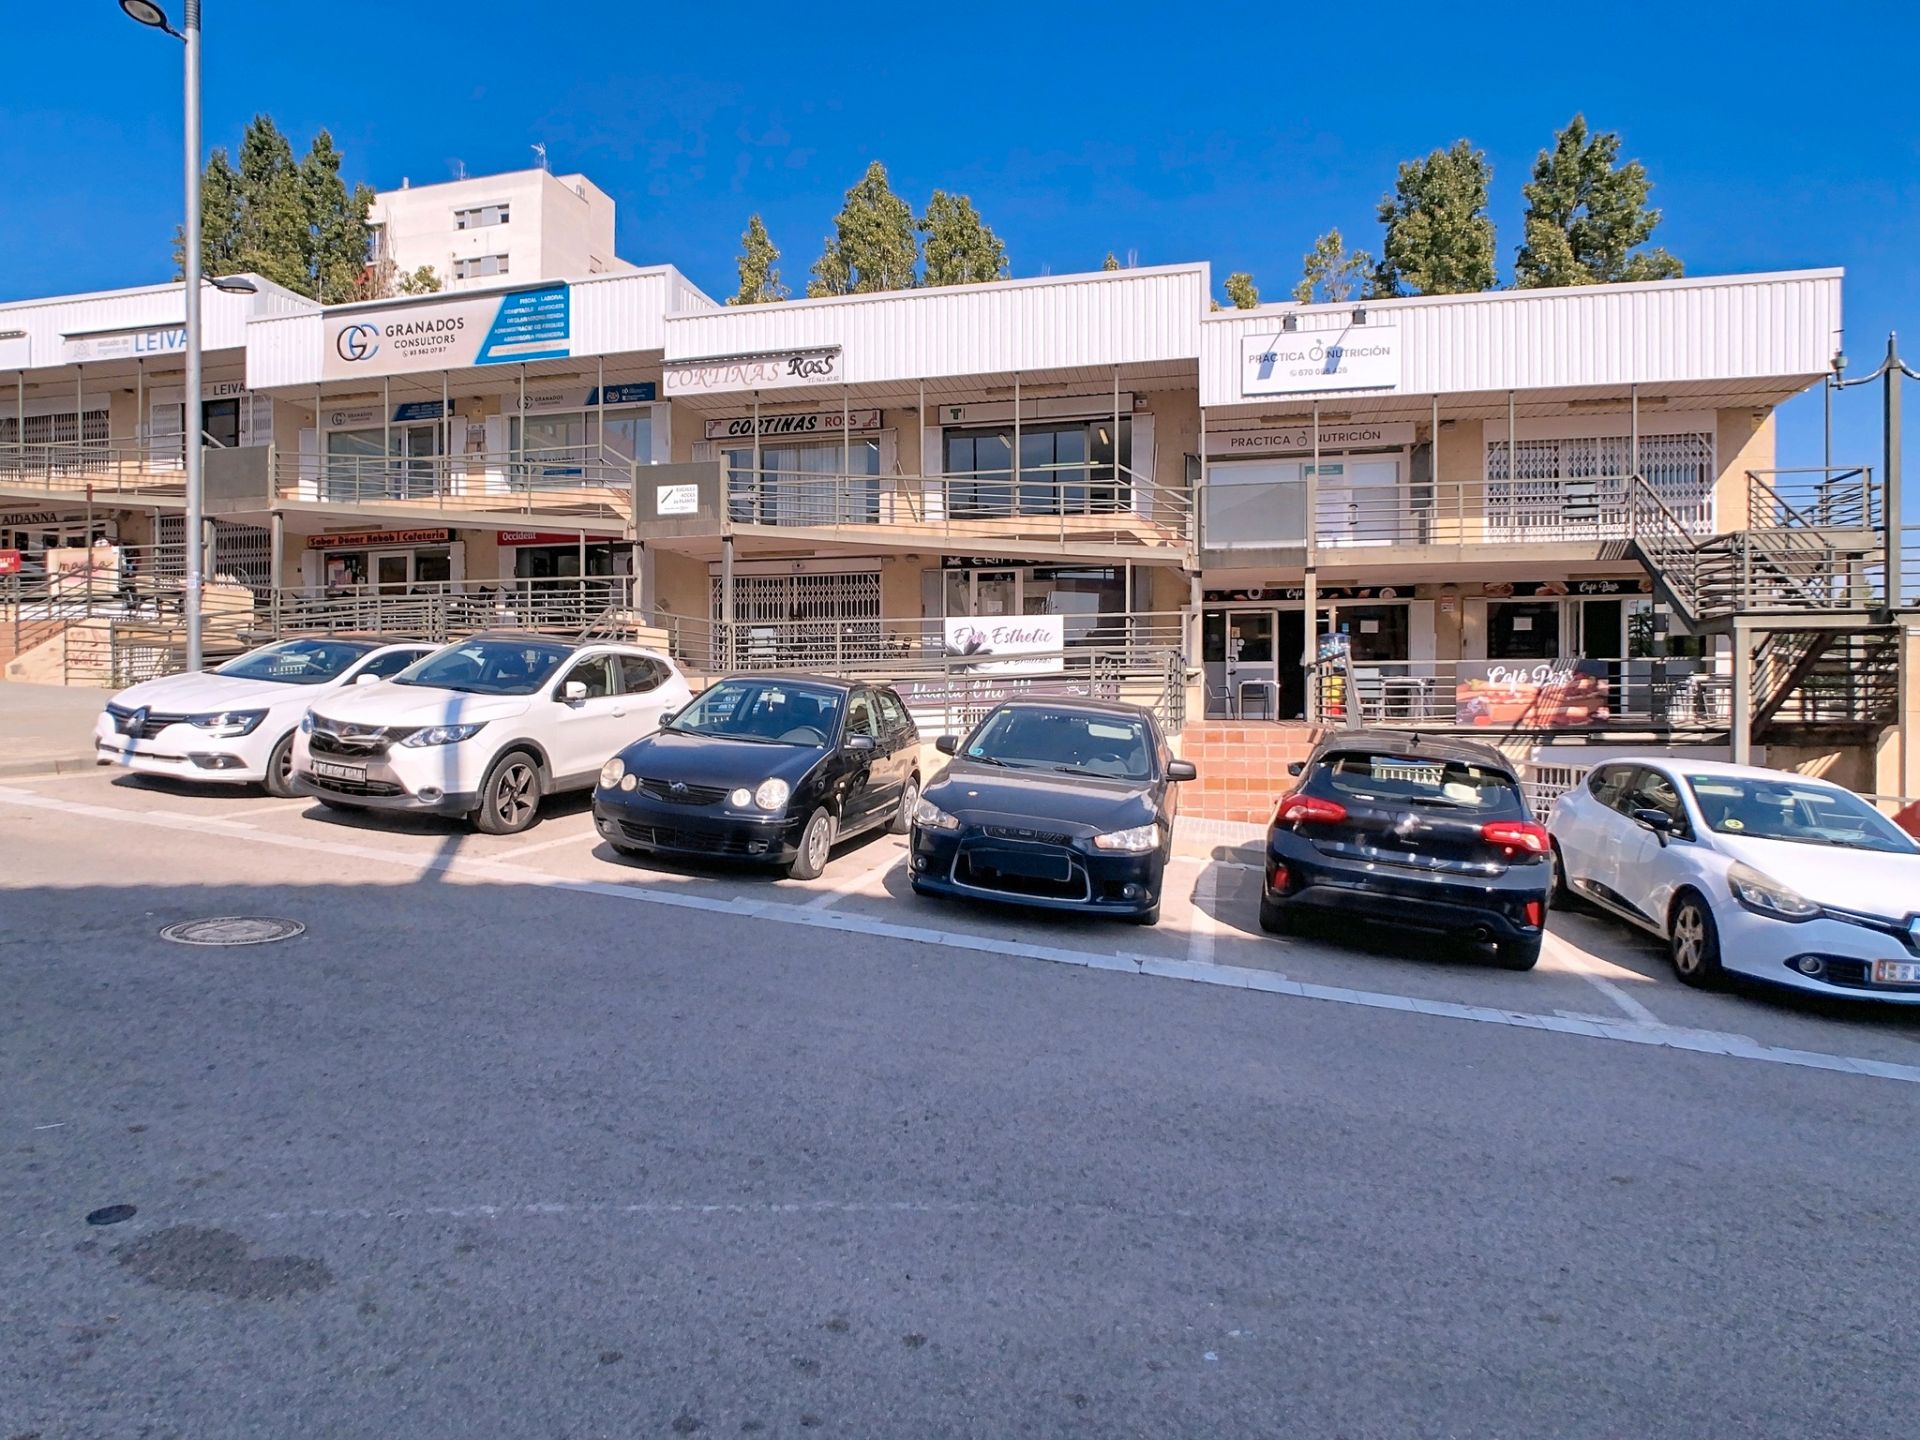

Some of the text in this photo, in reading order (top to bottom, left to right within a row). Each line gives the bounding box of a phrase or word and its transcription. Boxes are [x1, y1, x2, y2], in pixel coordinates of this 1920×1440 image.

[385, 317, 465, 338] GRANADOS
[134, 329, 187, 352] LEIVA
[394, 334, 456, 349] CONSULTORS
[1248, 345, 1391, 363] PRACTICA NUTRICIÓN
[666, 362, 781, 389] CORTINAS
[213, 382, 246, 396] LEIVA
[534, 394, 564, 402] GRANADOS
[728, 415, 818, 435] CORTINAS
[1230, 435, 1291, 447] PRACTICA
[366, 533, 395, 544] Kebab
[502, 531, 537, 541] Occident
[991, 626, 1053, 645] Esthetic
[1487, 665, 1528, 694] Café
